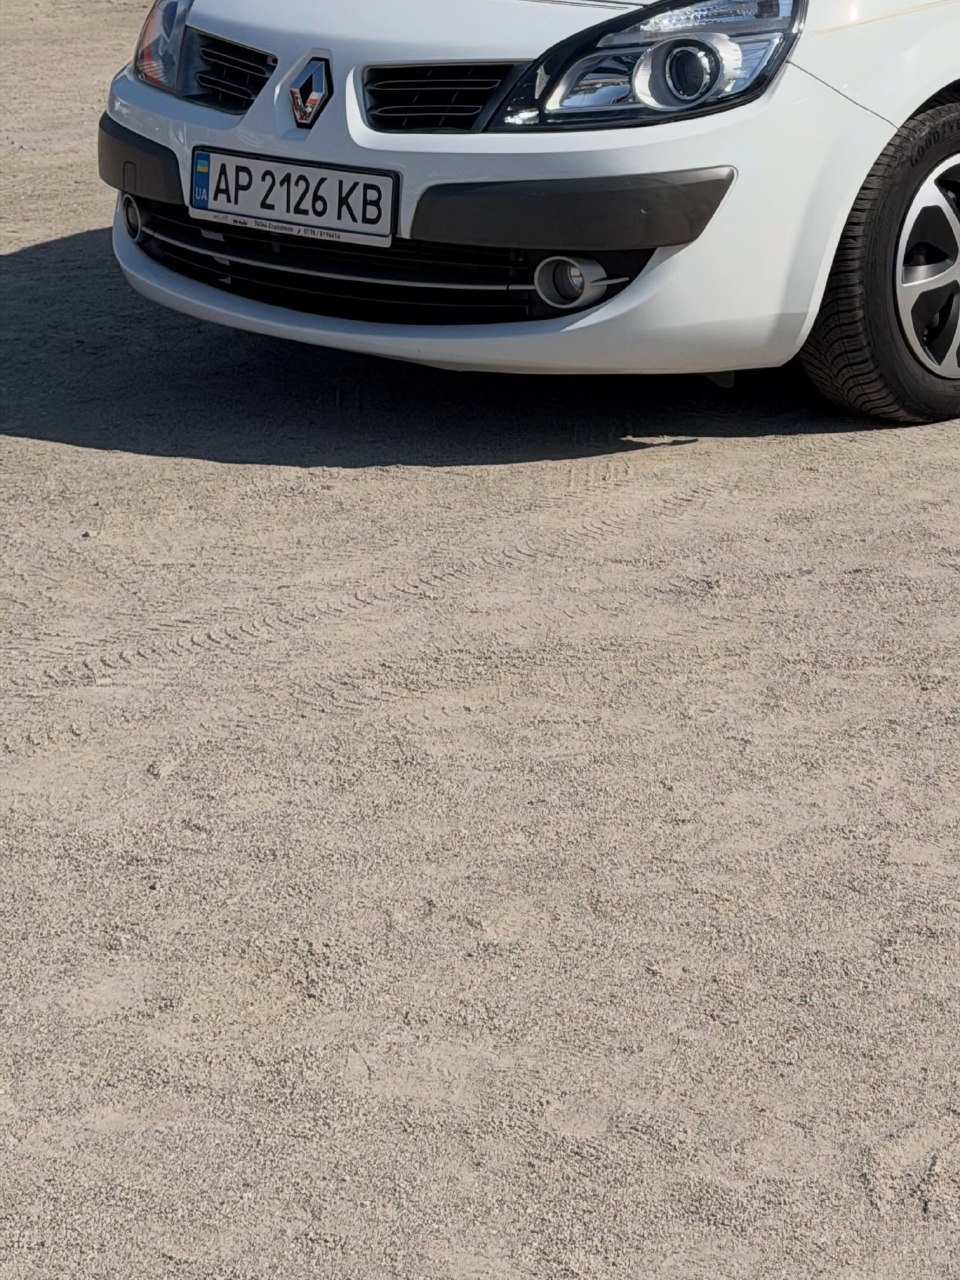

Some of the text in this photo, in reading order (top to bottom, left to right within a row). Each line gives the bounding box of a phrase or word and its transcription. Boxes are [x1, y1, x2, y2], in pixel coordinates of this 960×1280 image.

[195, 186, 209, 201] UA
[213, 162, 383, 226] AP 2126 KB
